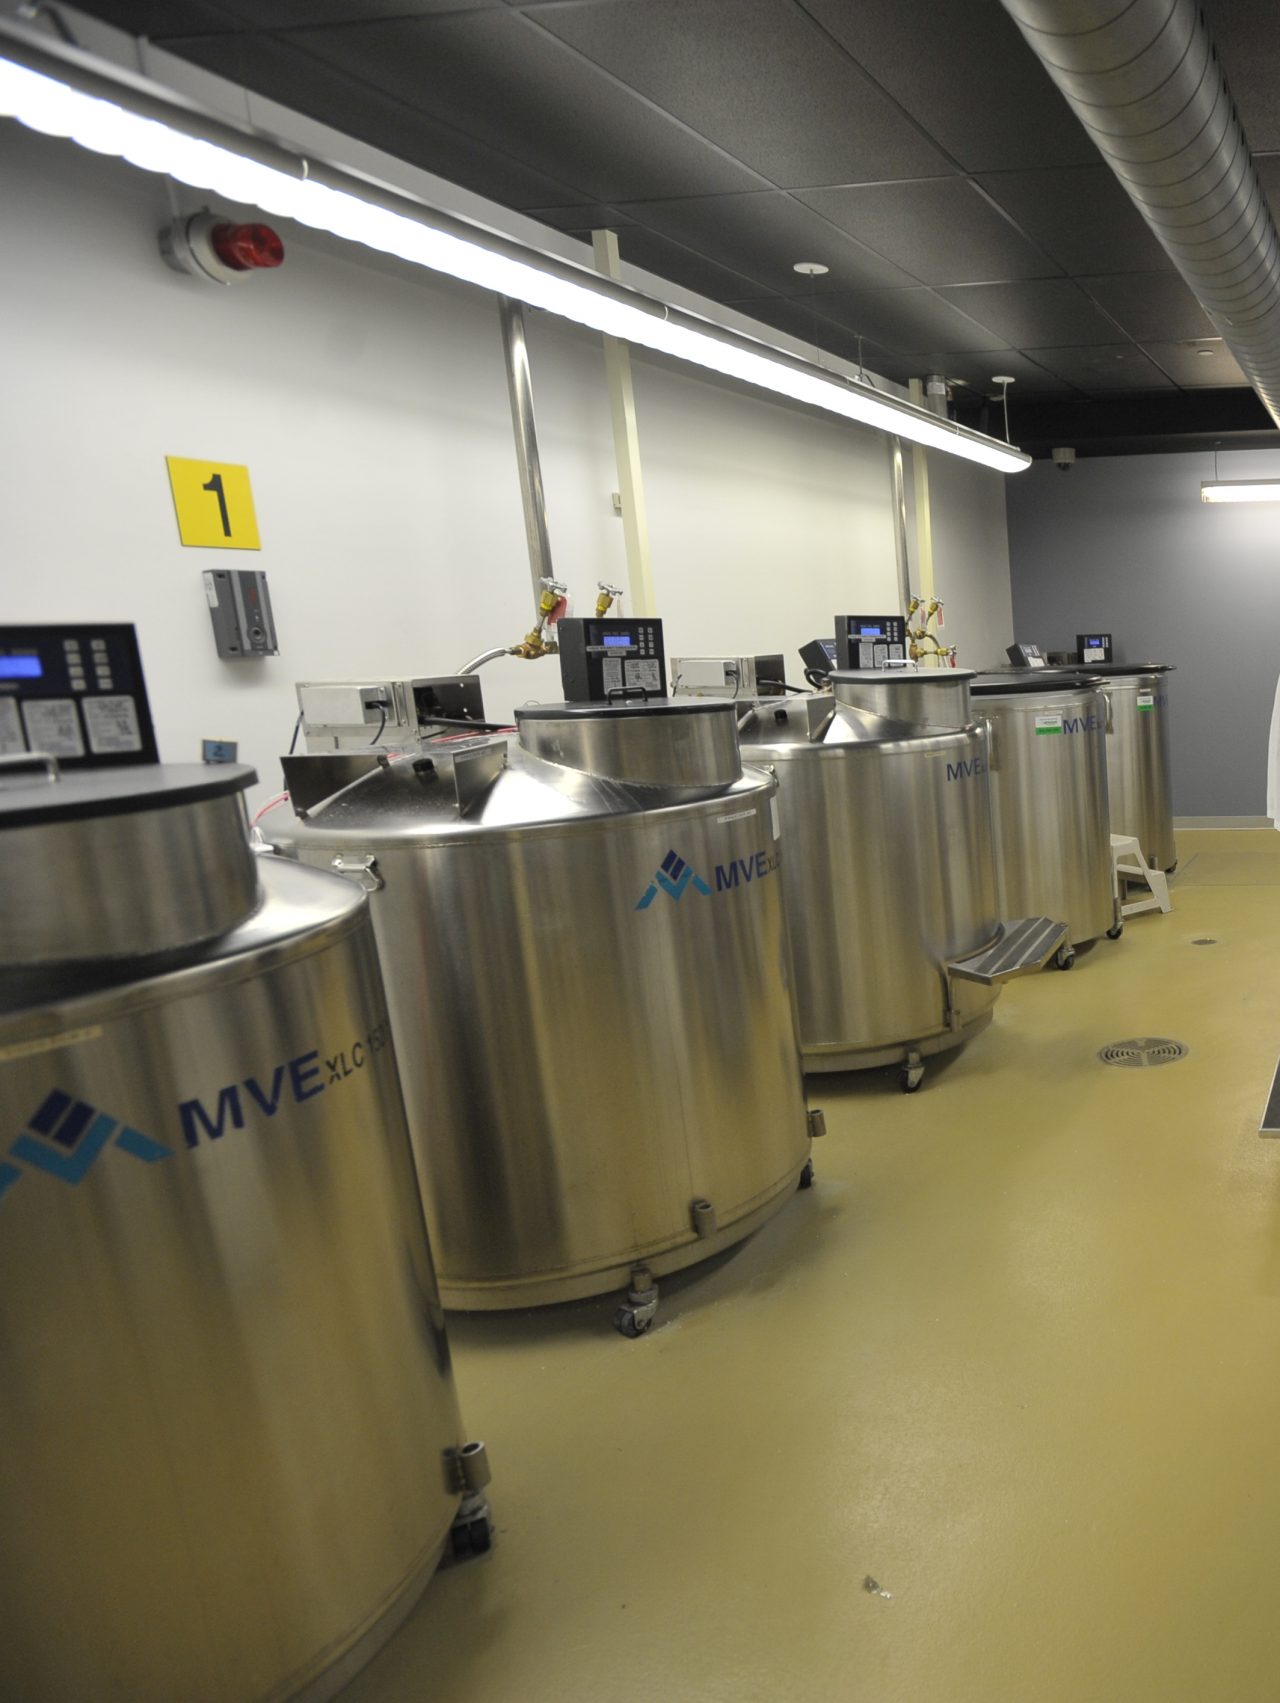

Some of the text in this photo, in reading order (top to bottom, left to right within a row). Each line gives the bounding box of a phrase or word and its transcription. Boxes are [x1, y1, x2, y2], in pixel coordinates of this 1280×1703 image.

[203, 474, 231, 537] 1
[1063, 715, 1097, 735] MVE
[946, 758, 980, 781] MVE
[715, 851, 768, 892] MVE
[178, 1050, 326, 1149] MVE
[325, 1042, 365, 1084] XLC
